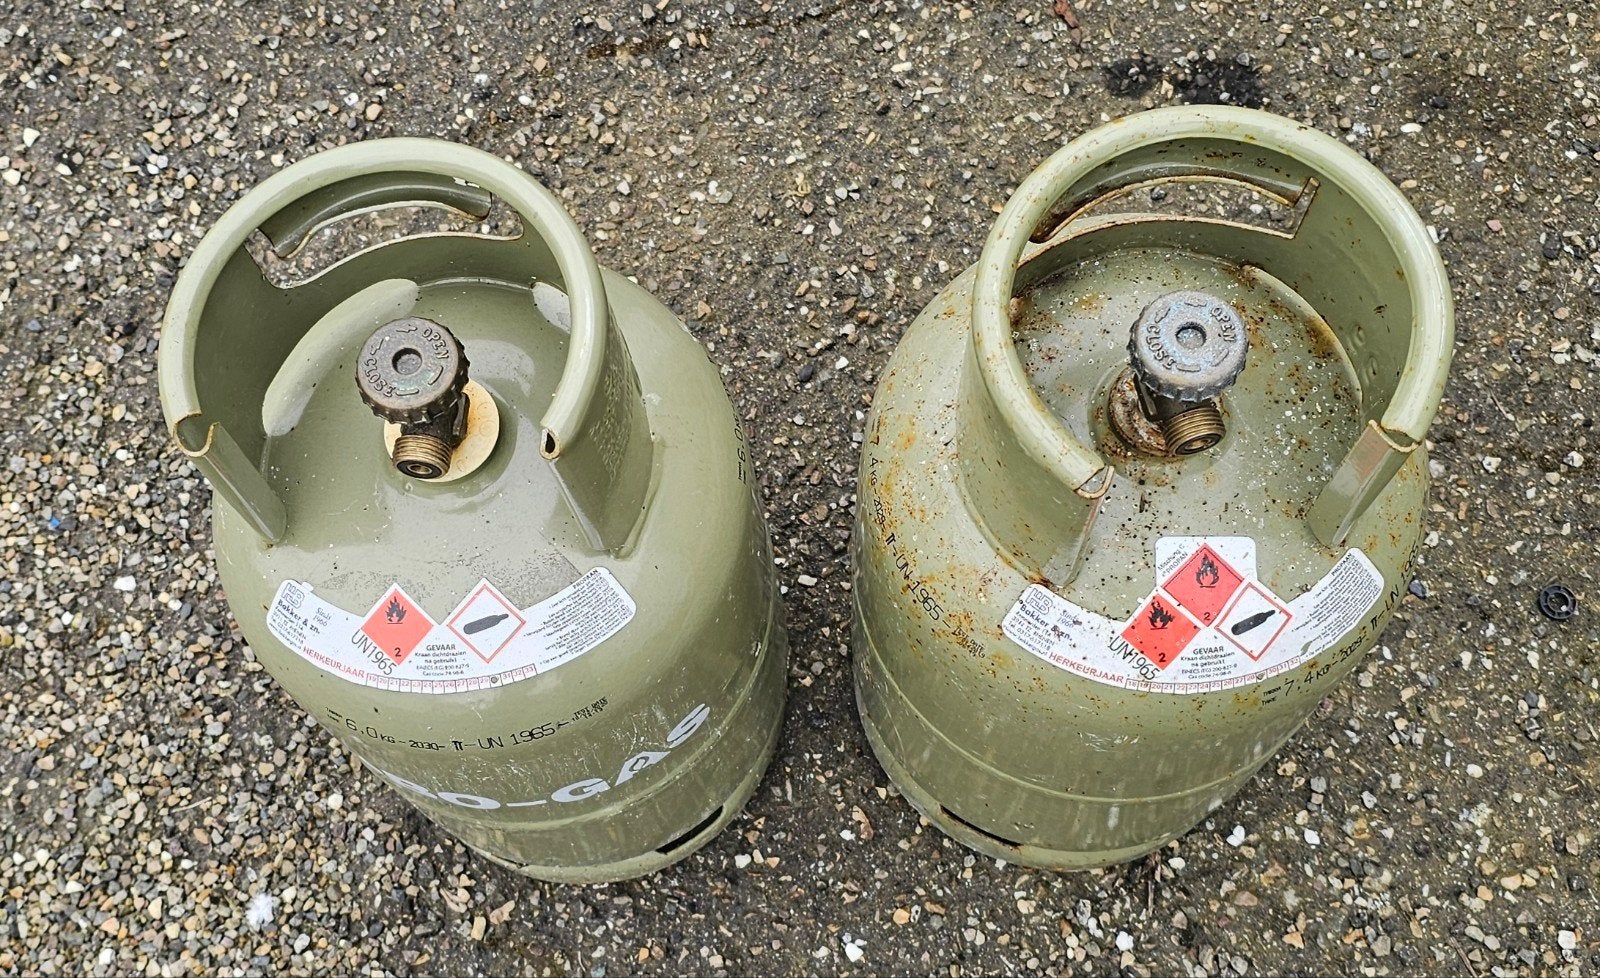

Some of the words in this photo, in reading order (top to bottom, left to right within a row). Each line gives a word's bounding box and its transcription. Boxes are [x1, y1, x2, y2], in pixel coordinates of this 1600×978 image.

[1210, 307, 1236, 342] OPEN
[422, 327, 449, 360] OPEN
[1146, 323, 1175, 370] CLOSE
[364, 358, 396, 398] CLOSE
[573, 569, 599, 589] PROPAAN
[1331, 553, 1353, 576] PROPAAN
[277, 599, 301, 621] Bakker
[302, 618, 308, 627] &
[907, 580, 944, 620] 1965
[1020, 603, 1049, 627] Bakker
[1203, 612, 1211, 621] 2
[303, 646, 365, 678] HERKEURJAAR
[351, 629, 397, 675] UN1965
[394, 647, 402, 657] 2
[1108, 635, 1161, 681] UN1965
[1158, 652, 1167, 663] 2
[1192, 646, 1224, 655] GEVAAR
[1049, 652, 1124, 683] HERKEURJAAR
[509, 722, 556, 746] 1965
